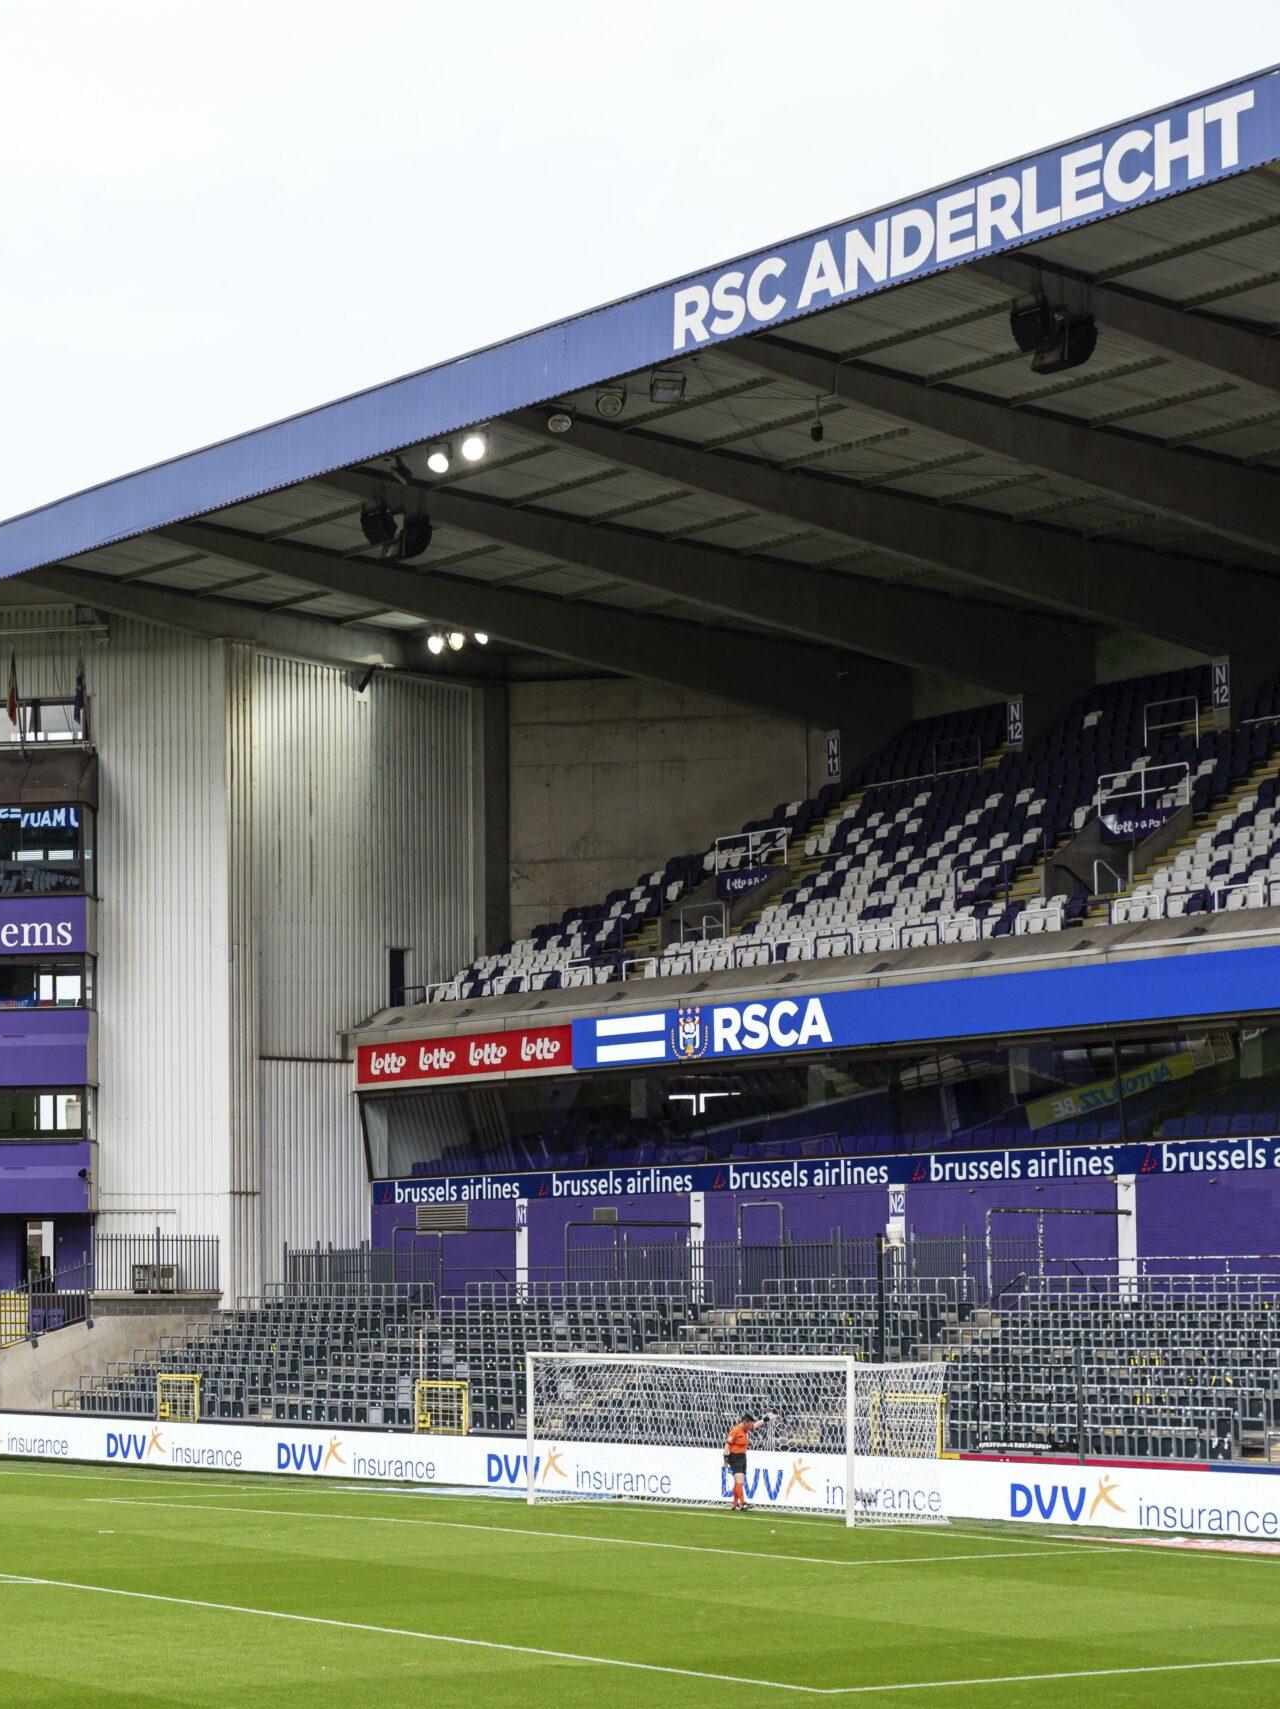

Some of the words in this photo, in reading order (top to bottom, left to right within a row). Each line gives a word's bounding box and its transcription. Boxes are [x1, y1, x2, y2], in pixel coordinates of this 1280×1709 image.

[673, 256, 787, 351] RSC
[796, 89, 1255, 310] ANDERLECHT
[1215, 665, 1226, 685] N
[1213, 685, 1229, 704] 12
[1010, 703, 1020, 721] N
[1008, 721, 1022, 740] 12
[829, 738, 838, 756] N
[713, 998, 834, 1053] RSCA
[370, 1051, 407, 1076] lotto
[418, 1046, 456, 1071] lotto
[468, 1041, 508, 1067] lotto
[520, 1036, 561, 1062] lotto
[930, 1150, 1021, 1182] brussels
[1026, 1148, 1114, 1178] airlines
[1162, 1138, 1267, 1173] brussels
[394, 1178, 457, 1203] brussels
[461, 1175, 520, 1200] airlines
[552, 1170, 622, 1198] brussels
[626, 1168, 693, 1194] airlines
[729, 1161, 809, 1190] brussels
[813, 1158, 889, 1186] airlines
[889, 1193, 905, 1214] N2
[6, 1432, 69, 1457] insurance
[106, 1432, 147, 1460] DVV
[171, 1440, 243, 1469] insurance
[276, 1442, 324, 1472] DVV
[353, 1452, 436, 1481] insurance
[487, 1453, 541, 1485] DVV
[576, 1464, 672, 1496] insurance
[1010, 1482, 1087, 1522] DVV
[1138, 1496, 1280, 1536] insurance
